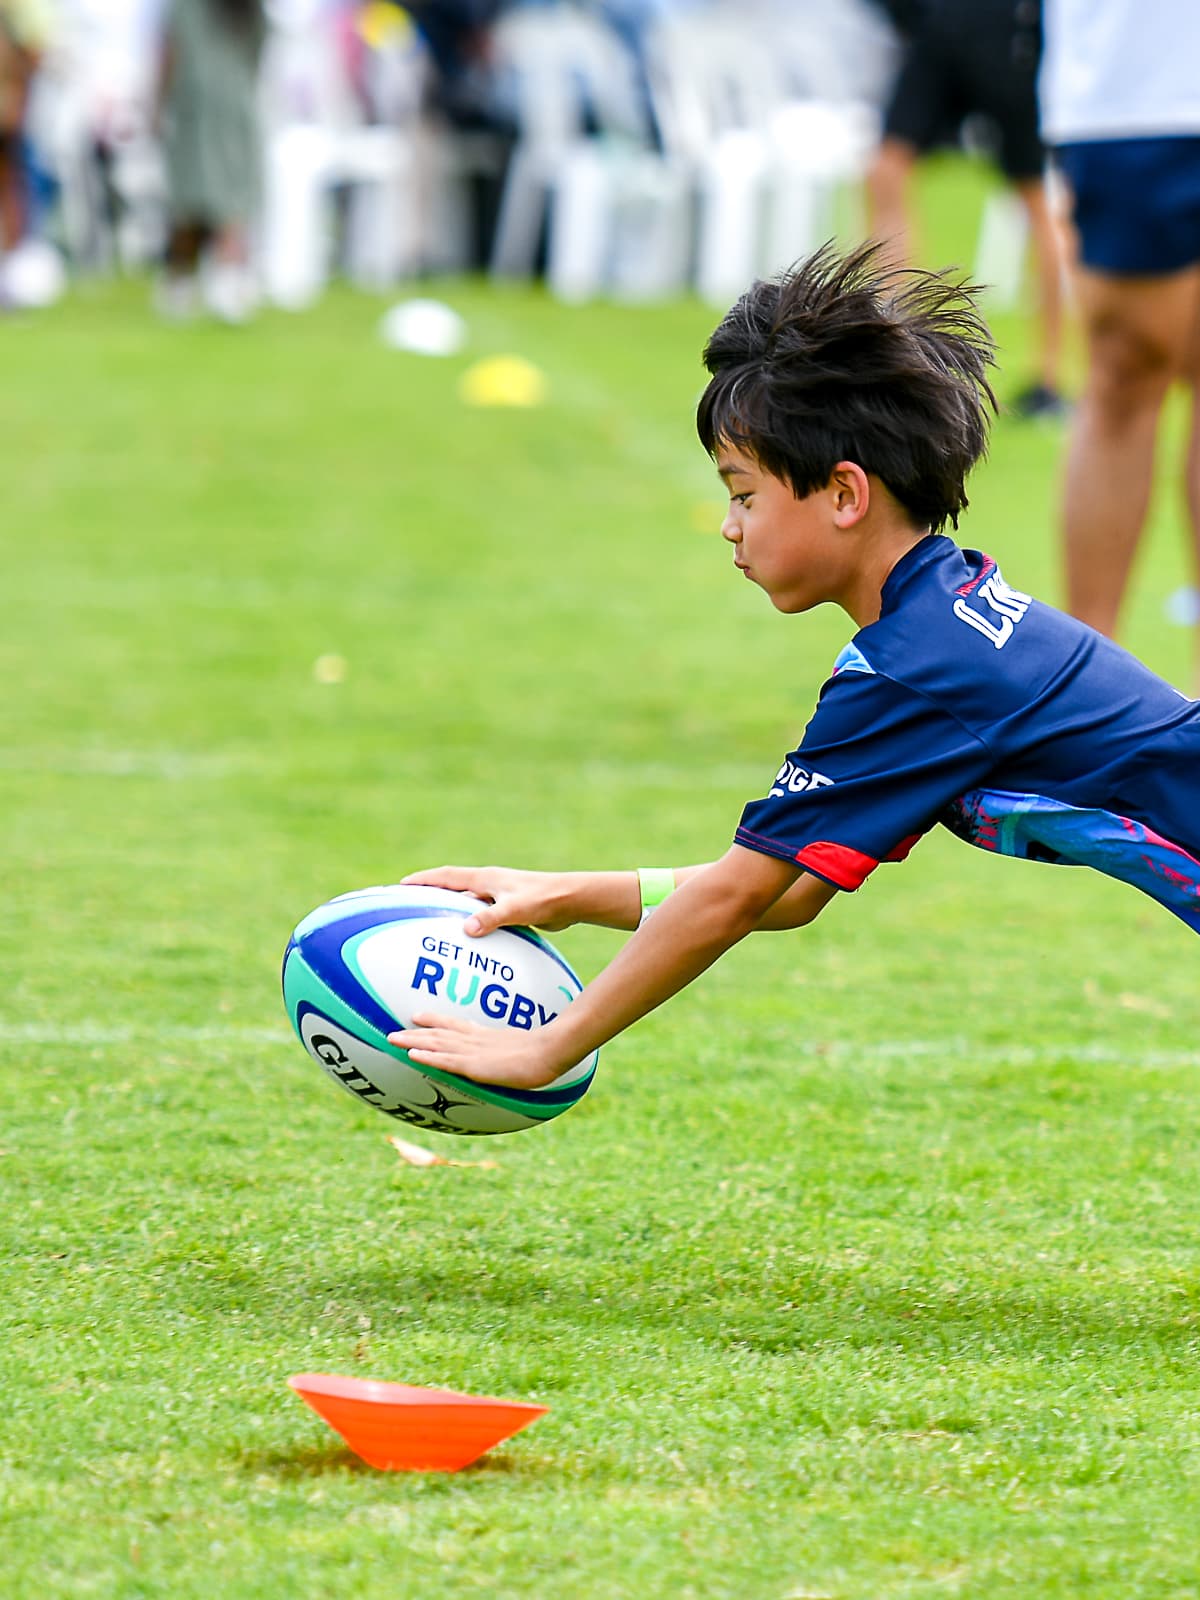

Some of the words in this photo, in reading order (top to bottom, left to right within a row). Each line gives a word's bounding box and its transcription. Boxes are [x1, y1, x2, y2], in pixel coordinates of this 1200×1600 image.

[422, 936, 463, 961] GET
[468, 951, 514, 982] INTO
[411, 956, 558, 1031] RUGBY
